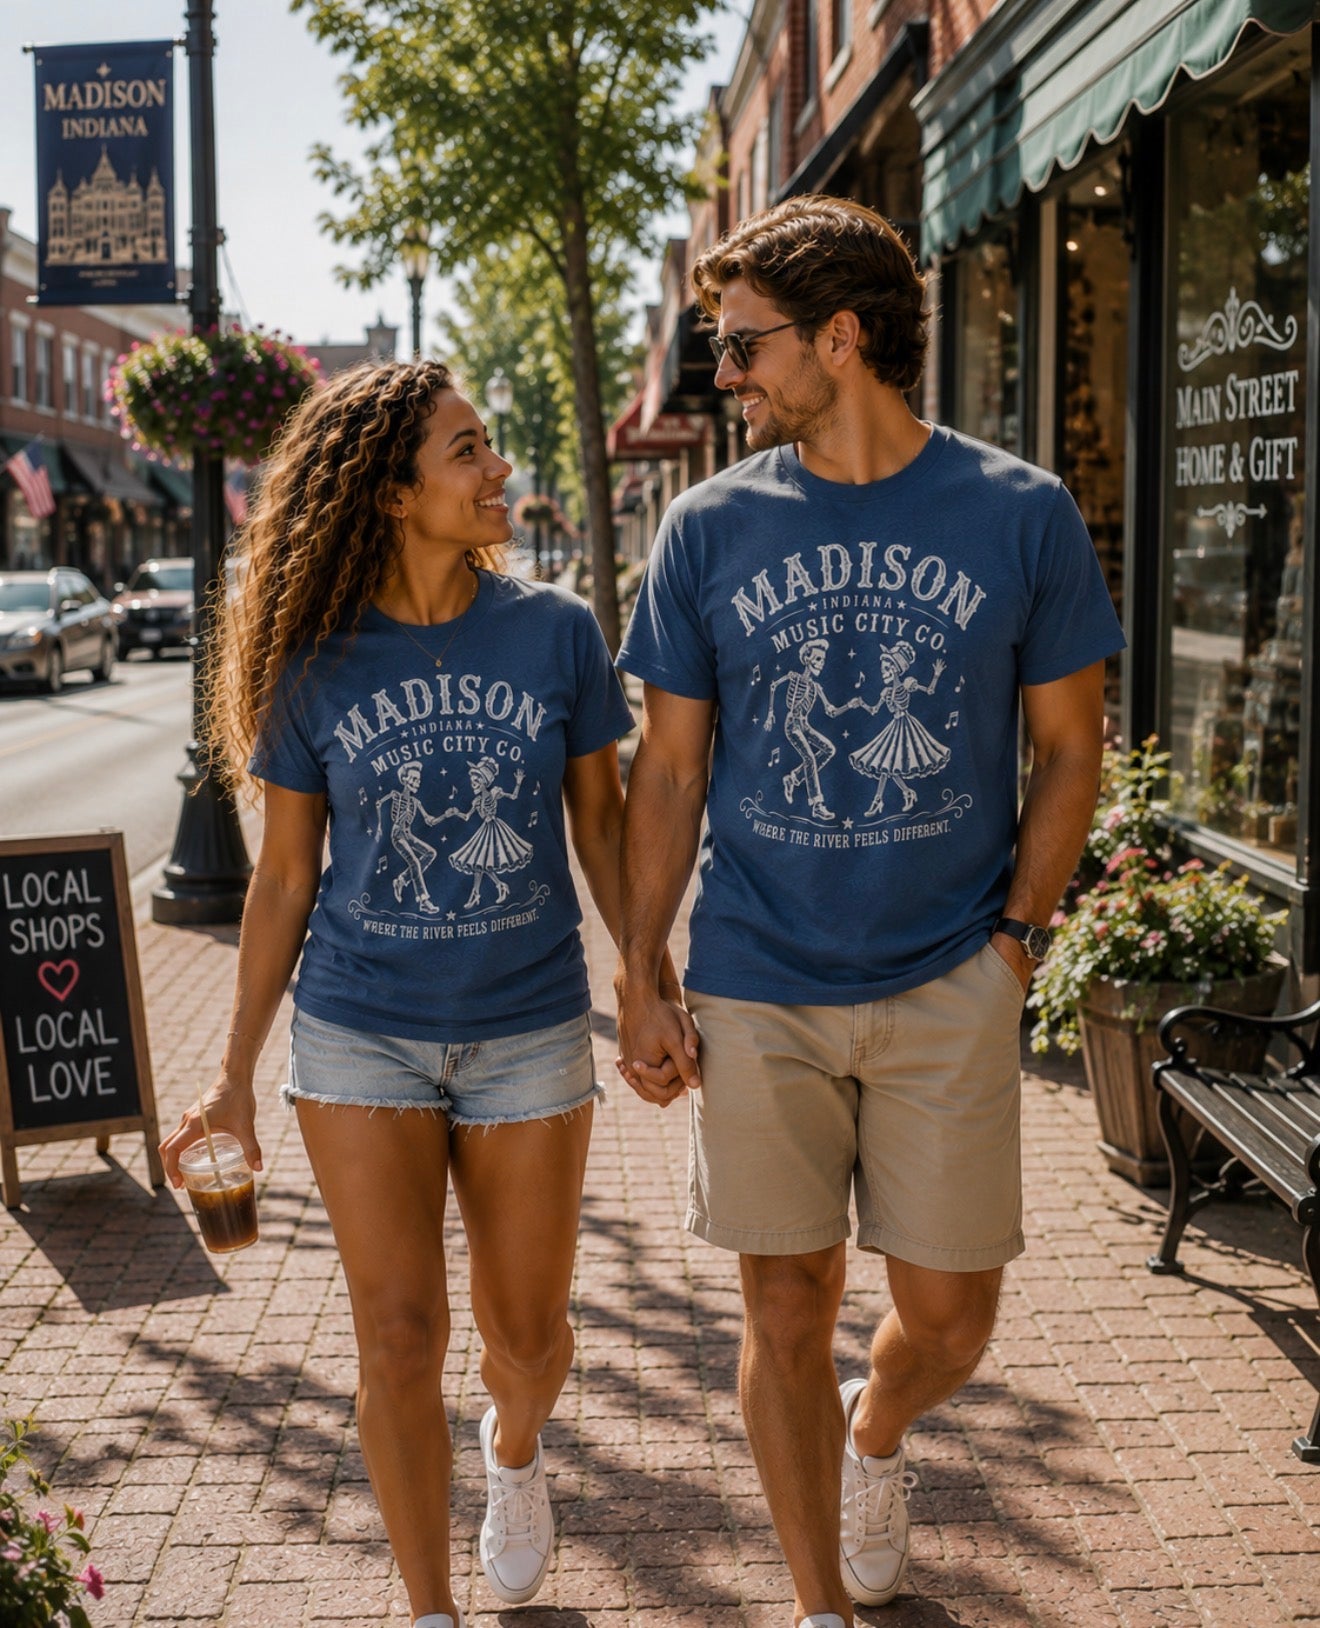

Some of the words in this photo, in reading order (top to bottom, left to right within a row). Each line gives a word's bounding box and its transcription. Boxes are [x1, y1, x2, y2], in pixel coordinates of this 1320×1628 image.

[44, 79, 166, 111] MADISON
[62, 116, 148, 139] INDIANA
[1176, 385, 1221, 429] MAIN
[1225, 370, 1299, 422] STREET
[1175, 444, 1226, 486] HOME
[1229, 442, 1244, 483] &
[1249, 436, 1298, 482] GIFT
[731, 542, 987, 637] MADISON
[822, 594, 892, 609] INDIANA
[770, 613, 844, 654] MUSIC
[855, 612, 910, 637] CITY
[915, 624, 947, 654] CO.
[334, 674, 547, 763] MADISON
[412, 720, 473, 736] INDIANA
[370, 739, 434, 776] MUSIC
[443, 735, 490, 754] CITY
[496, 740, 525, 764] CO.
[752, 819, 786, 841] WHERE
[789, 829, 810, 846] THE
[813, 833, 850, 848] RIVER
[3, 868, 102, 910] LOCAL
[9, 912, 105, 955] SHOPS
[400, 925, 419, 940] THE
[422, 925, 454, 940] RIVER
[15, 1008, 118, 1053] LOCAL
[28, 1056, 117, 1102] LOVE
